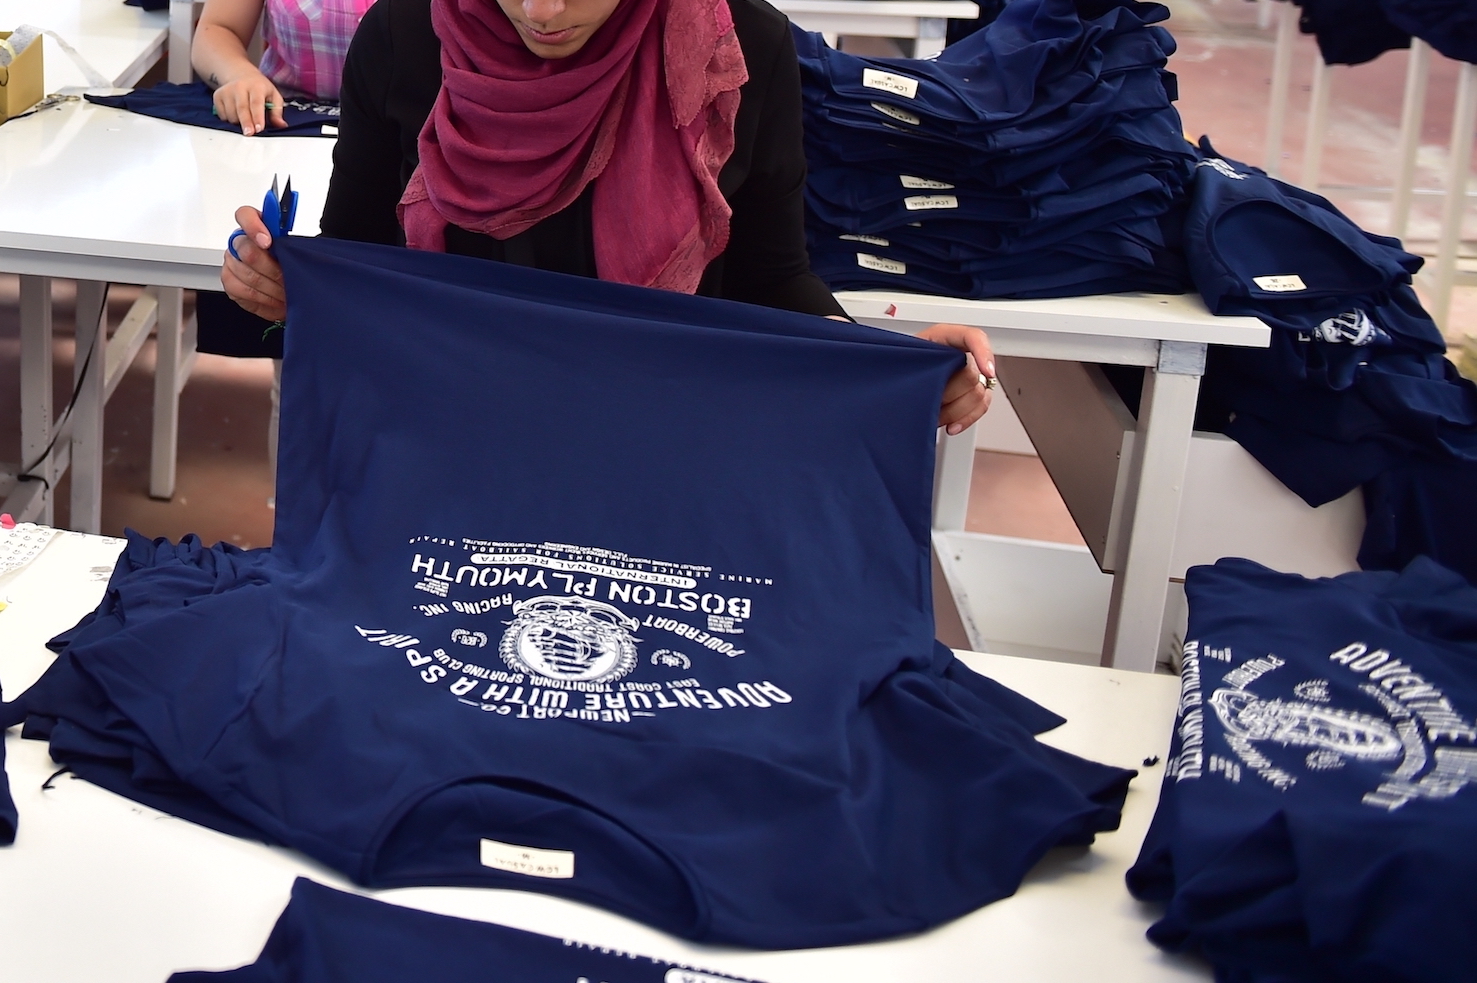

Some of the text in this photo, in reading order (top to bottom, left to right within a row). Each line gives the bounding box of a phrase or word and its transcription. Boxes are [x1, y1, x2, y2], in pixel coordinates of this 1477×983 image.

[463, 543, 527, 554] SAILBOAT
[535, 548, 560, 559] FOR
[480, 555, 689, 586] INTERNATIONAL REGATTA
[568, 553, 643, 570] SOLUTIONS
[651, 566, 711, 579] SERVICE
[410, 553, 599, 599] PLYMOUTH
[718, 573, 774, 586] MARINE
[412, 602, 450, 618] INC.
[451, 592, 514, 616] RACING
[607, 580, 753, 620] BOSTON
[641, 614, 746, 659] POWERBOAT
[354, 624, 448, 684] SPIRIT
[433, 647, 701, 693] EAST COAST TRADITIONAL SPORTING CLUB
[449, 676, 480, 696] A
[481, 683, 569, 709] WITH
[584, 680, 793, 710] ADVENTURE
[516, 703, 631, 723] NEWPORT
